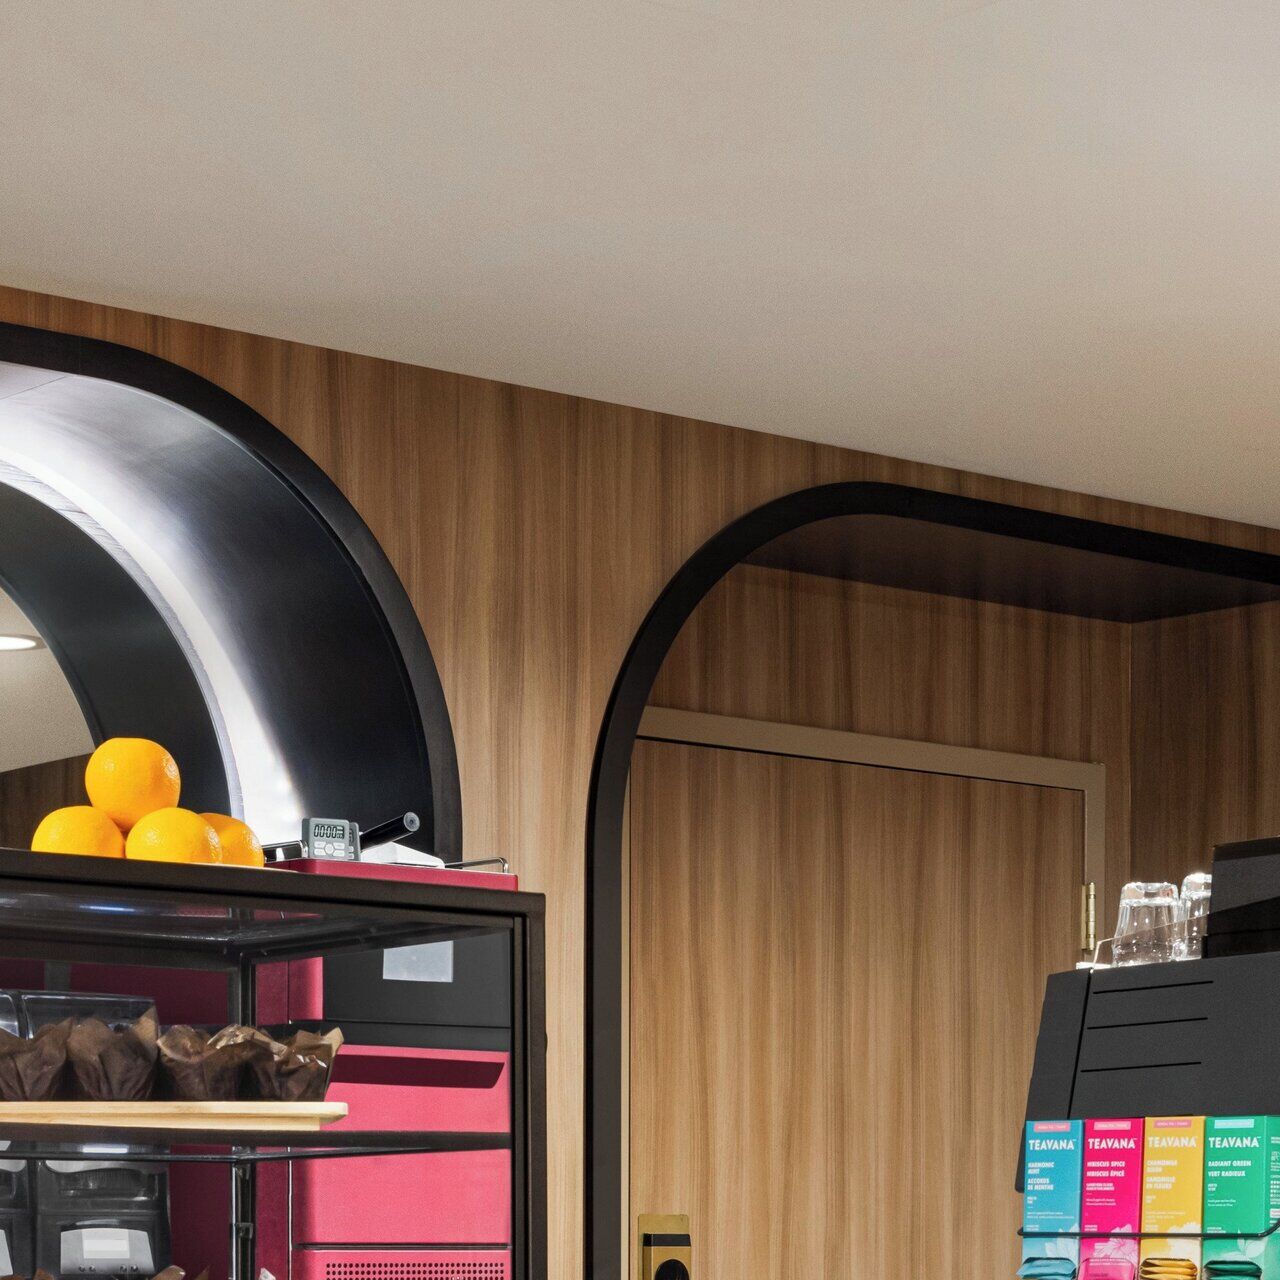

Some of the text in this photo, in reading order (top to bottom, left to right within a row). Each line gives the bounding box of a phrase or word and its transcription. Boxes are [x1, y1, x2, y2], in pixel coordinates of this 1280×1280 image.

[1028, 1139, 1075, 1151] TEAVANA
[1088, 1138, 1136, 1150] TEAVANA
[1148, 1136, 1197, 1148] TEAVANA
[1208, 1136, 1260, 1148] TEAVANA
